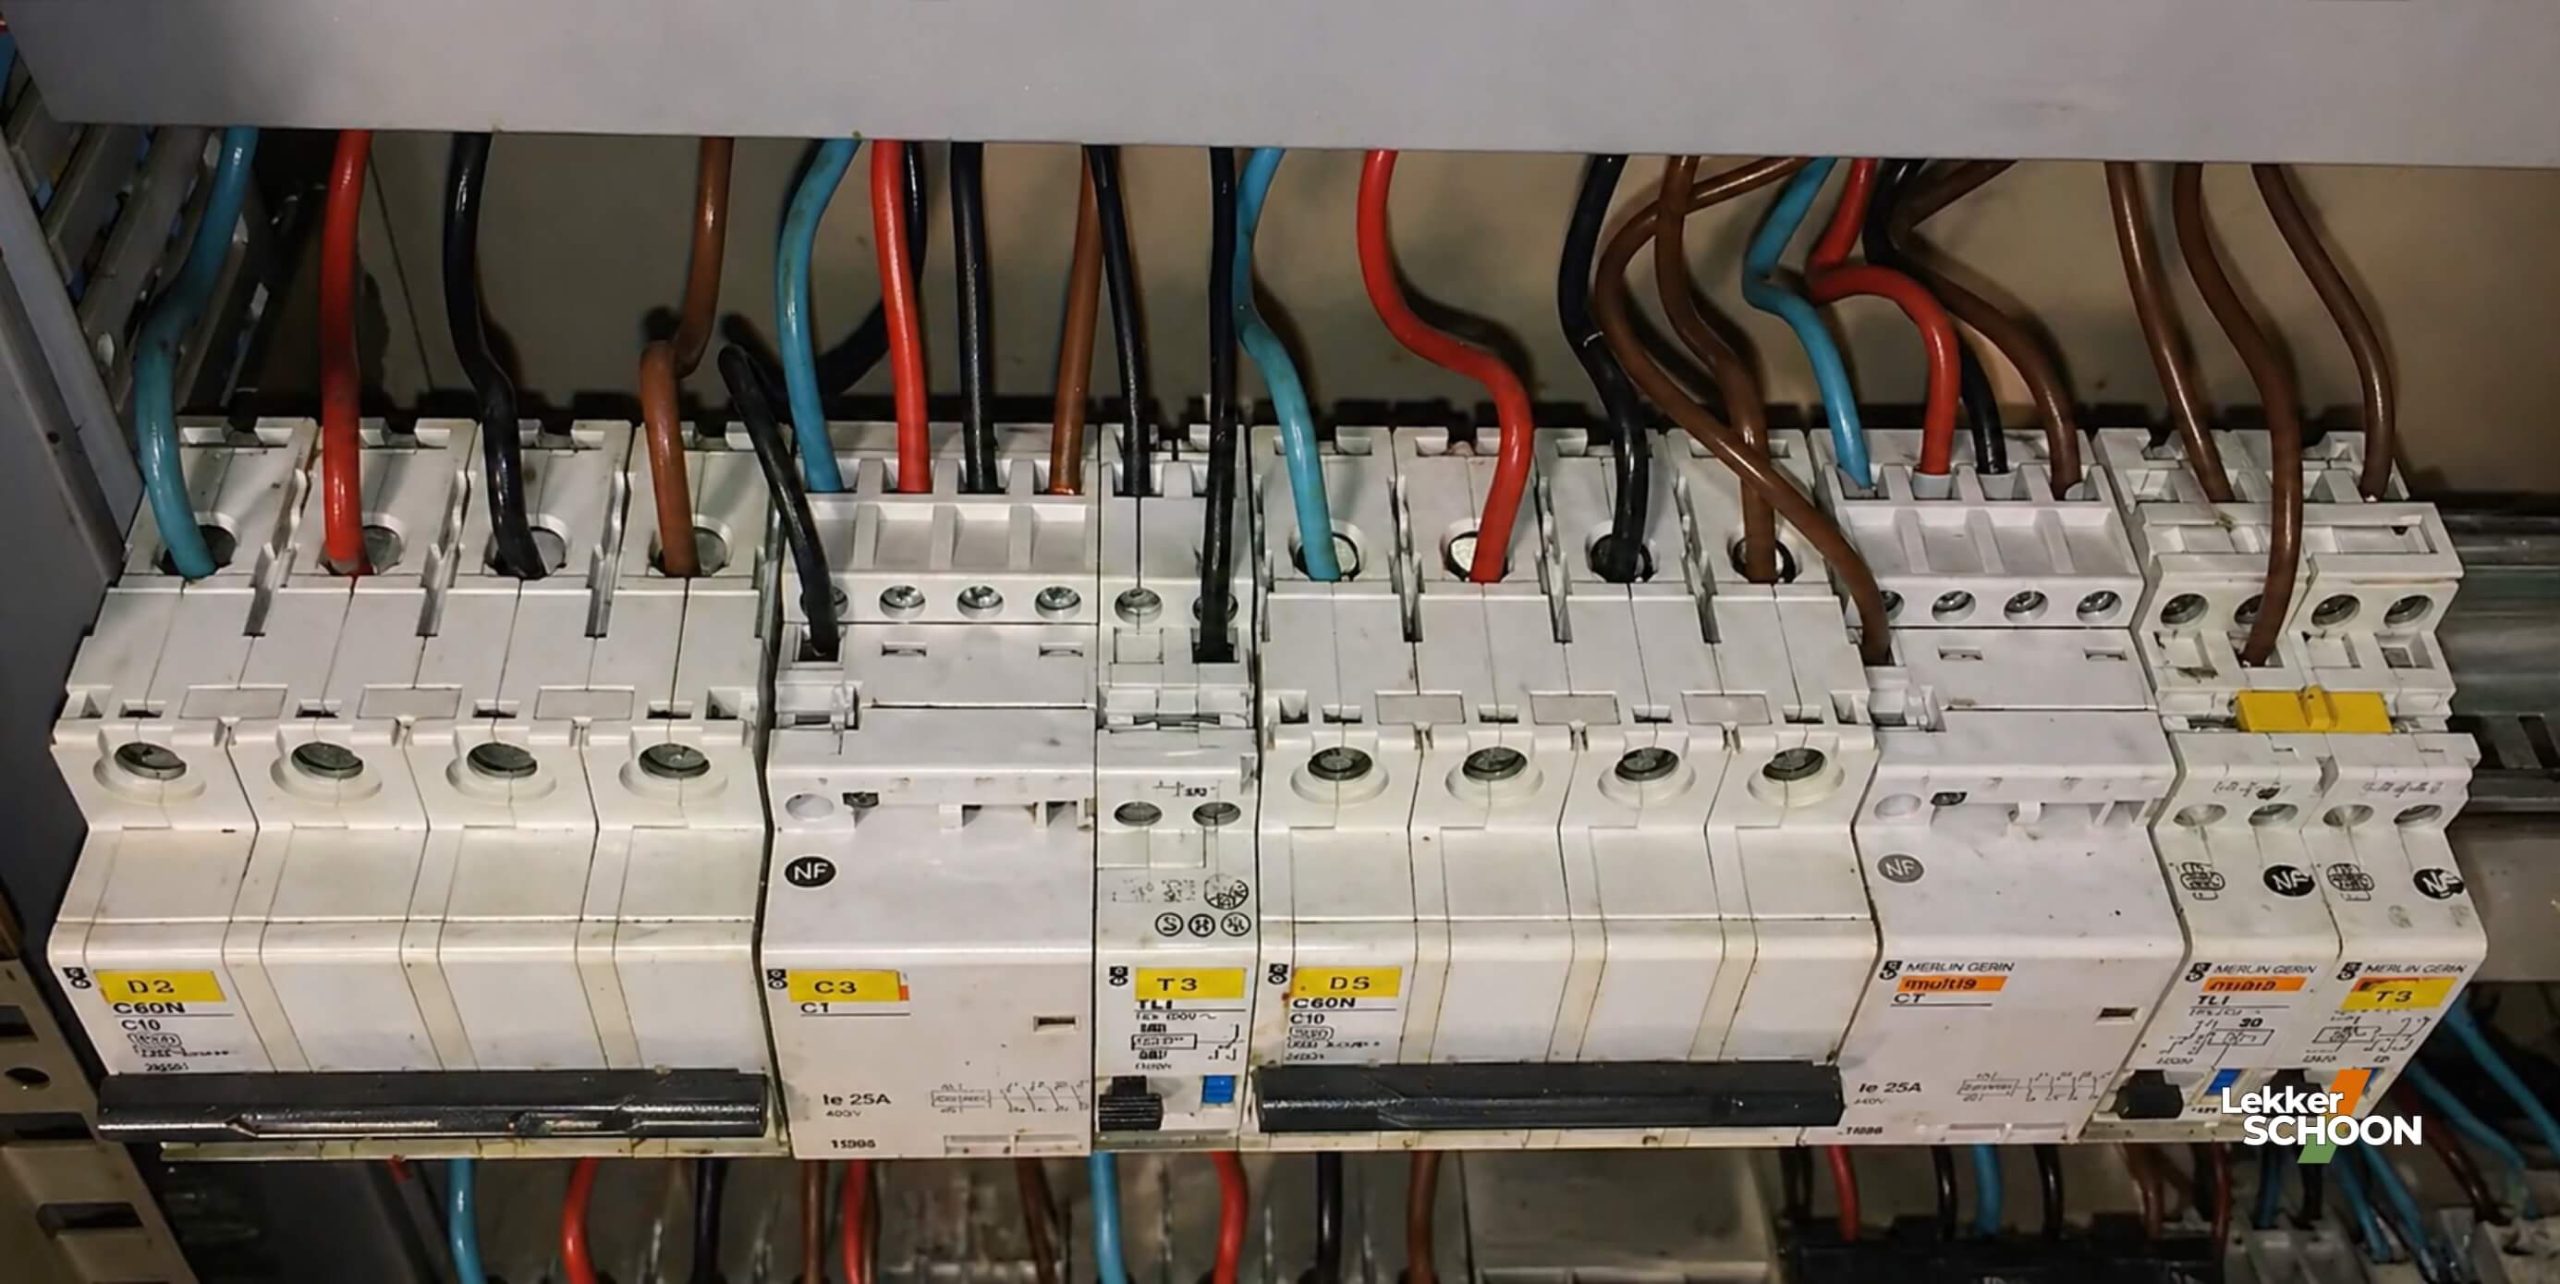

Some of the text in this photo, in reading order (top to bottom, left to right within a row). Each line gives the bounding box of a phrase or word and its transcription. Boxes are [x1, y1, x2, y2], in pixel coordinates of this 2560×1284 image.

[794, 862, 828, 880] NF
[1884, 859, 1915, 877] NF
[2271, 869, 2311, 890] NF
[1905, 962, 2015, 973] MERLIN GERIN
[2214, 964, 2318, 974] MERLIN GERIN
[2364, 963, 2468, 973] MERLIN GERIN
[127, 979, 176, 994] D2
[814, 980, 857, 994] C3
[1157, 978, 1198, 991] T3
[1893, 992, 1926, 1004] CT
[2375, 990, 2413, 1003] T3
[113, 1002, 186, 1014] C60N
[1292, 997, 1356, 1009] C60N
[121, 1019, 161, 1031] C10
[1290, 1013, 1325, 1025] C10
[1883, 1082, 1922, 1094] 25A
[849, 1093, 892, 1106] 25A
